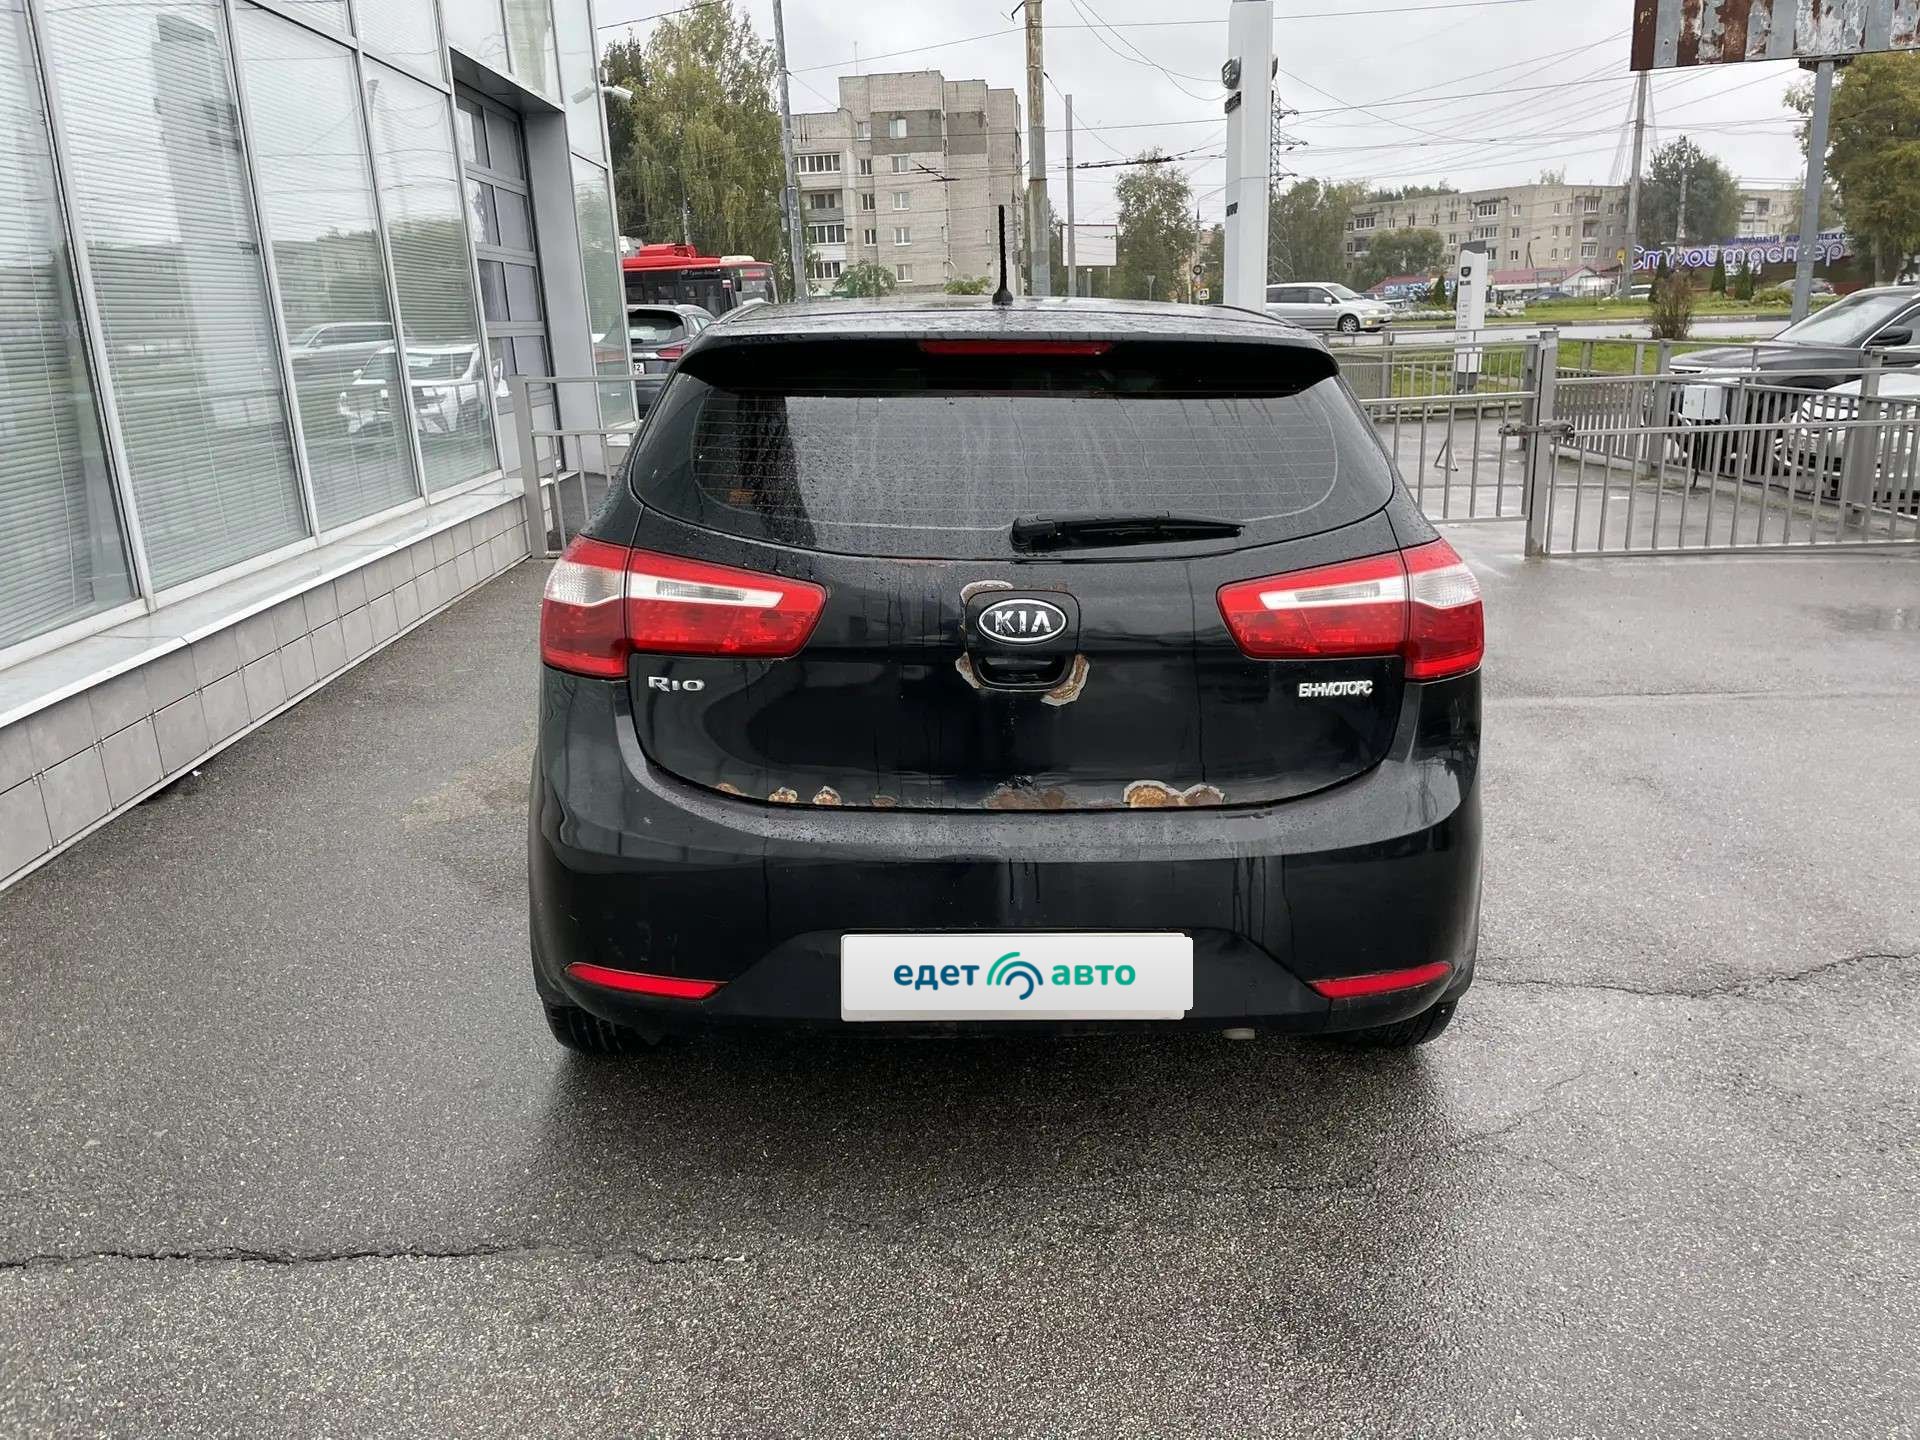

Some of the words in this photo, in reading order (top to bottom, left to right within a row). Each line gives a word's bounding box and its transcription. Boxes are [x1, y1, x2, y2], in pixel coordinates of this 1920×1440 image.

[1785, 231, 1846, 244] КОЛЕКС
[994, 610, 1053, 633] KIA
[1298, 680, 1373, 697] БН-МОТОРС
